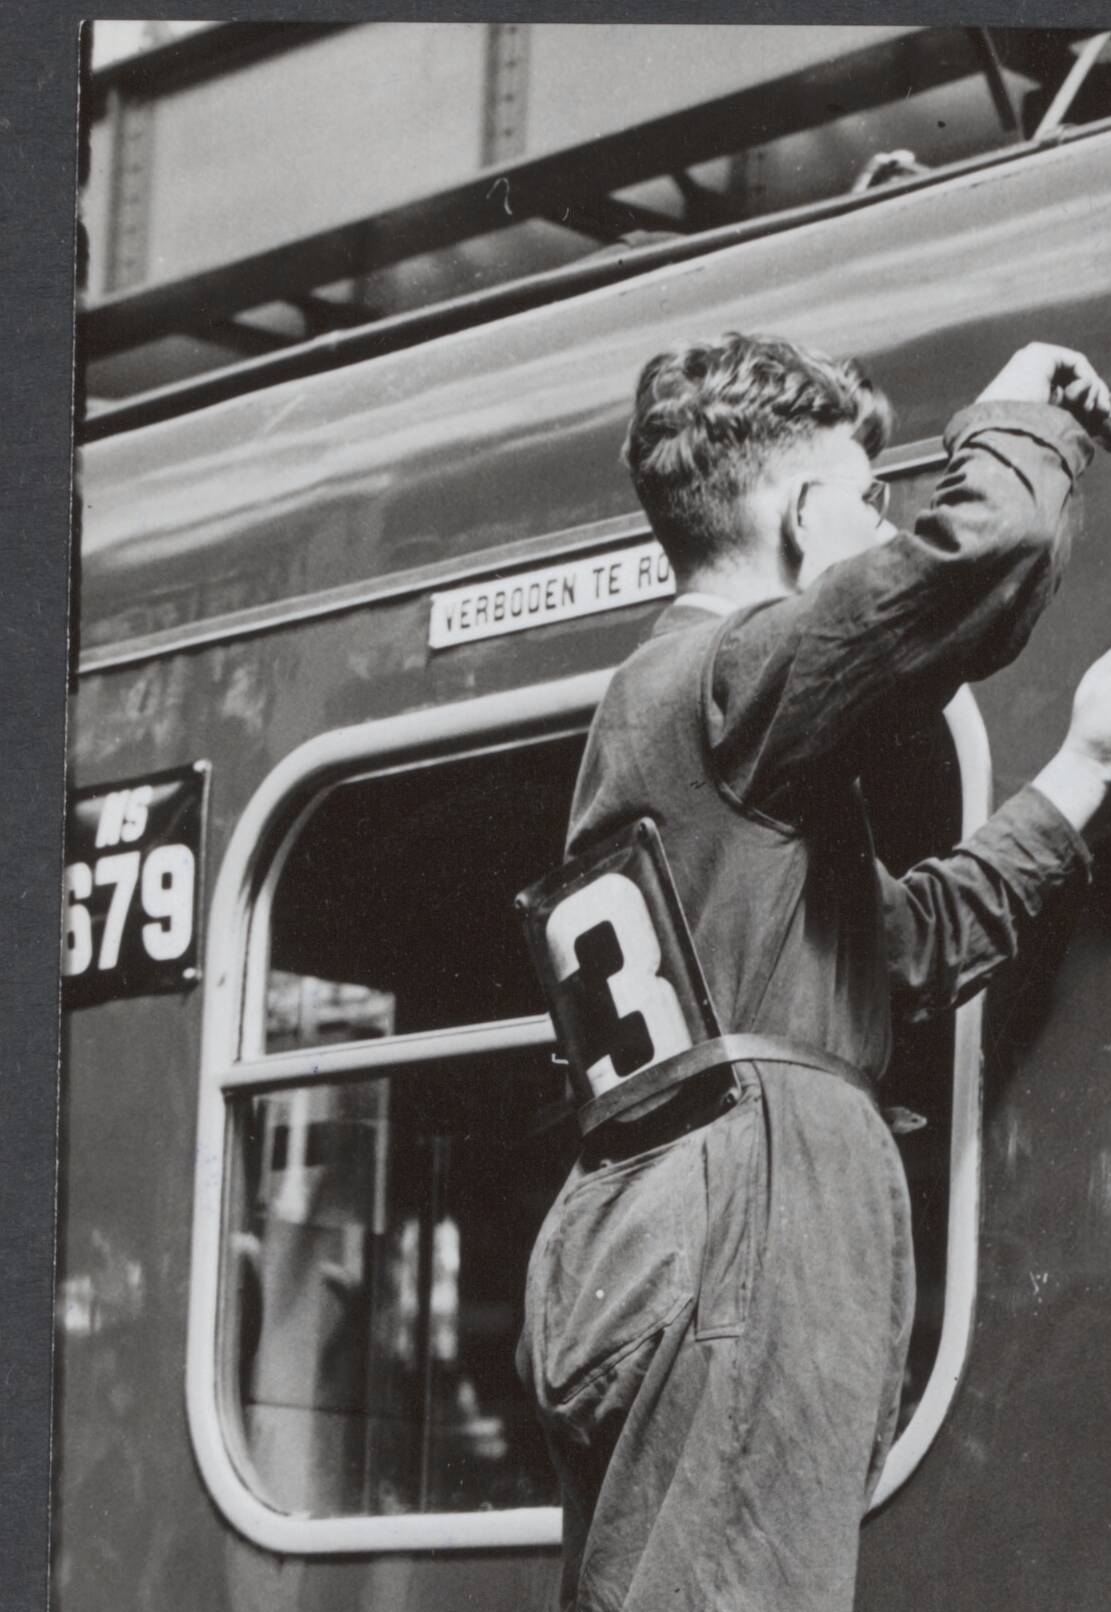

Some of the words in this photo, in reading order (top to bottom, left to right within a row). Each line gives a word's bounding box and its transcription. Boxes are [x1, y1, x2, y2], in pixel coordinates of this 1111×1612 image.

[445, 573, 577, 632] VERBODEN
[592, 563, 622, 598] TE
[97, 787, 154, 848] NS
[62, 843, 195, 977] 679
[546, 872, 693, 1098] 3
